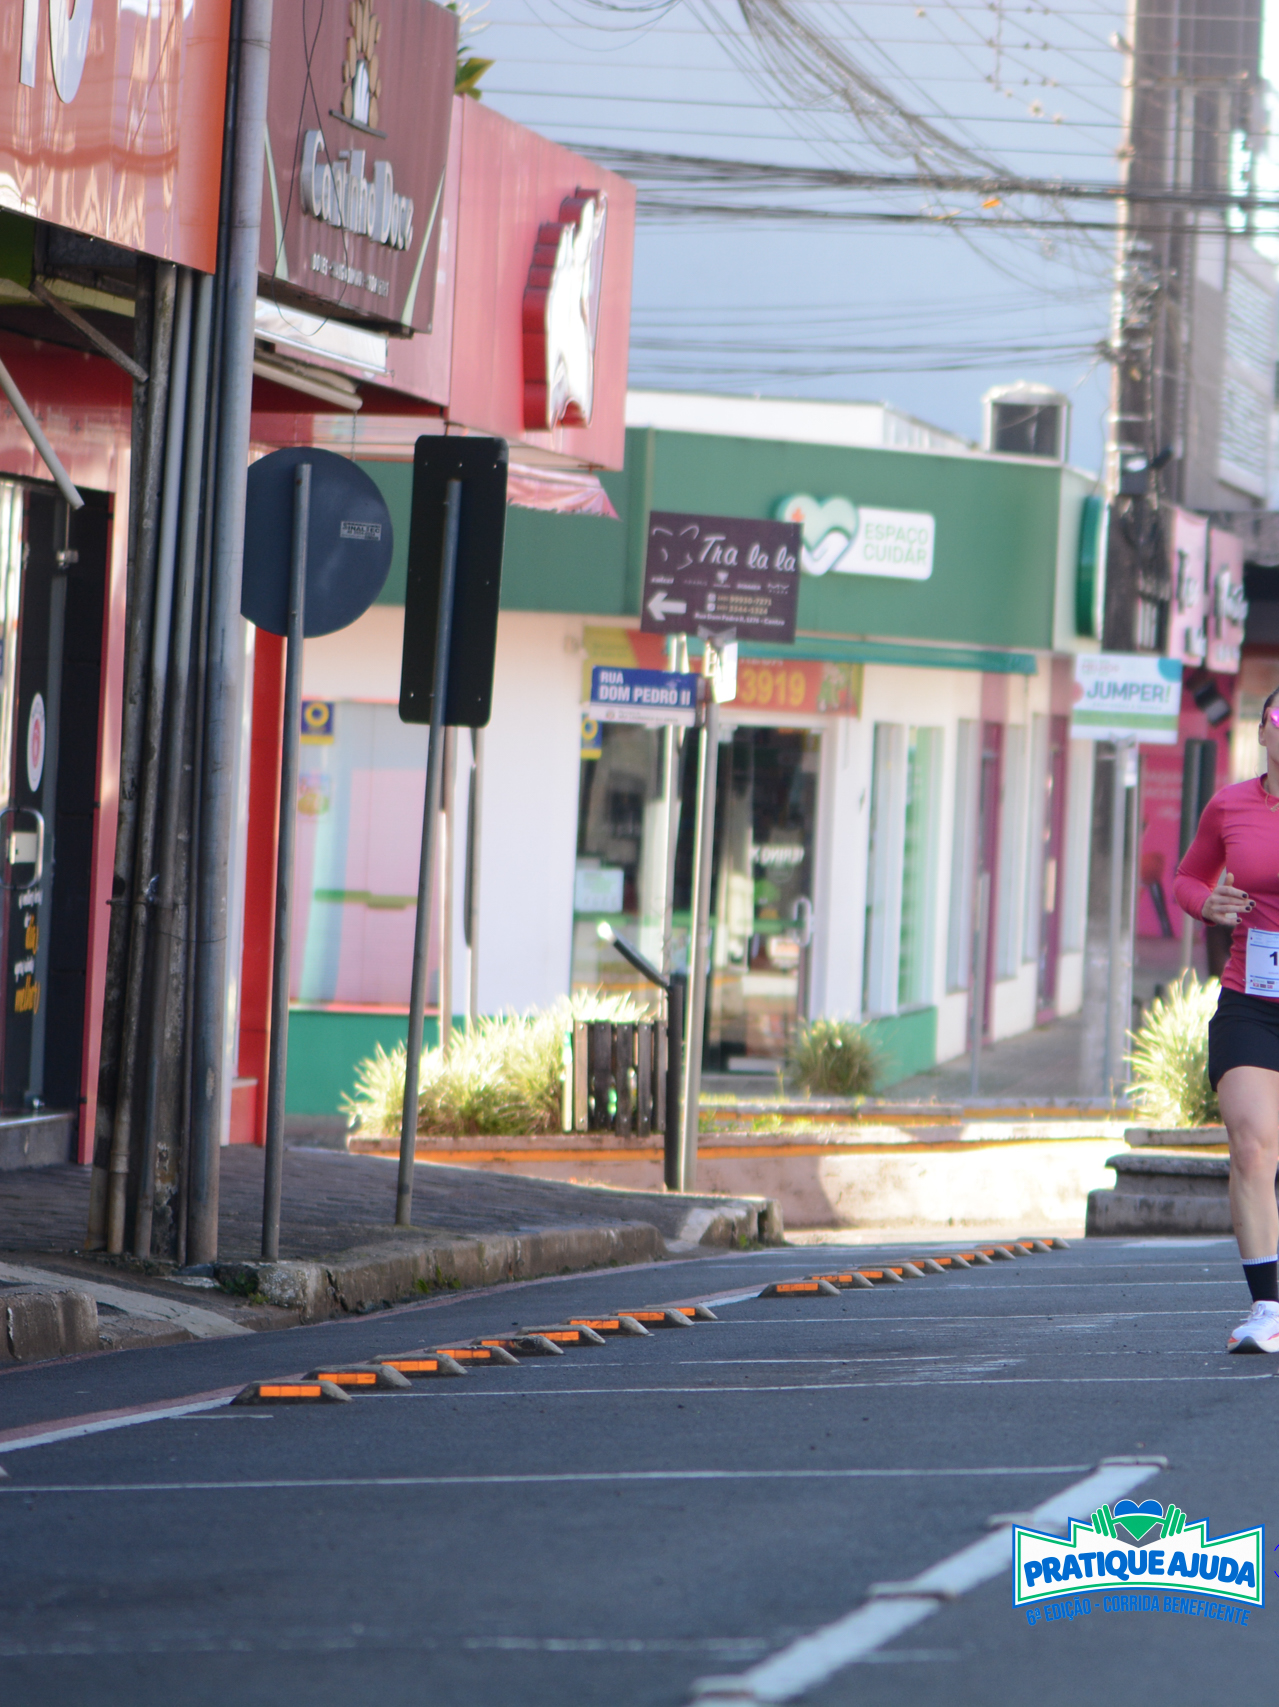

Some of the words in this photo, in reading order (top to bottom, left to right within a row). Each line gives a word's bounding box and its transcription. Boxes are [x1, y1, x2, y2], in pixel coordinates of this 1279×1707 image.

[374, 160, 414, 251] Doce
[865, 522, 929, 546] ESPAÇO
[700, 535, 739, 566] Tra
[747, 543, 769, 570] la
[774, 546, 796, 572] la
[863, 542, 927, 567] CUIDAR
[600, 671, 624, 685] RUA
[599, 685, 631, 702] DOM
[634, 687, 678, 705] PEDRO
[680, 689, 691, 705] II
[1086, 680, 1171, 703] JUMPER!
